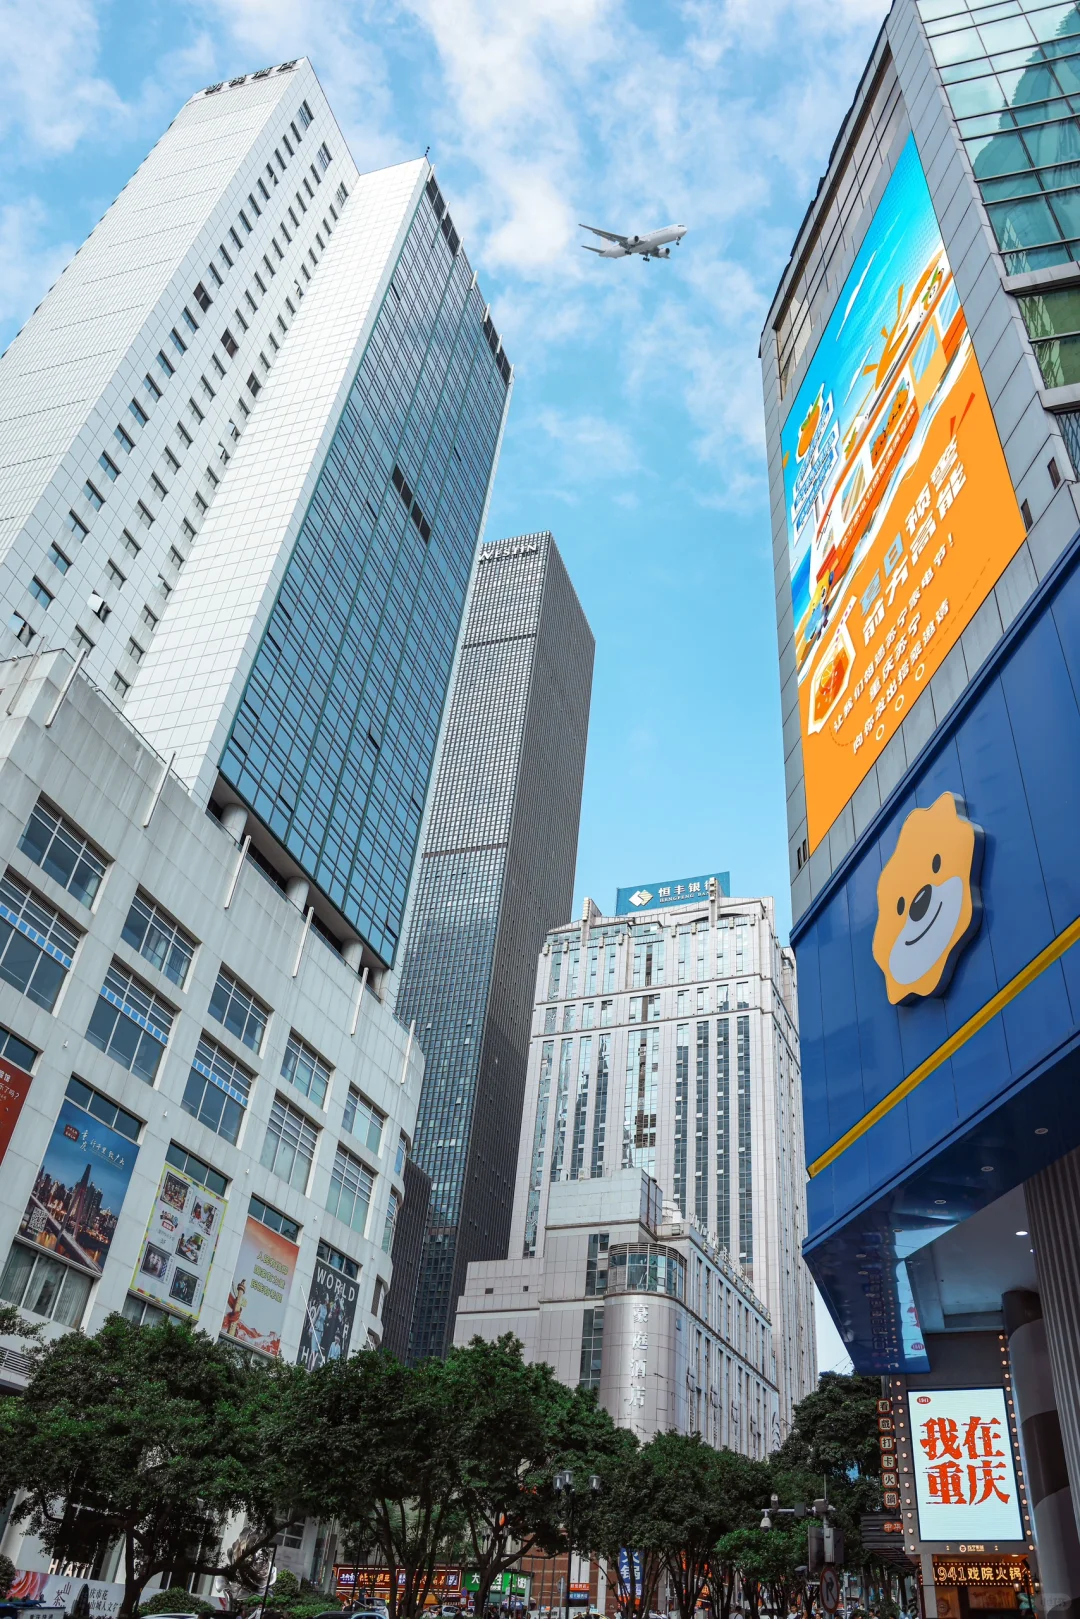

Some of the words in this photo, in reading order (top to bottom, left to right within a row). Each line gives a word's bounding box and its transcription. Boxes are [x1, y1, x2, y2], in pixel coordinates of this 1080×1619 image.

[860, 435, 957, 615] 夏日预警
[479, 543, 537, 560] WESTIN
[862, 462, 966, 645] 前方高能
[853, 599, 948, 753] 向你发出搭乘邀请
[869, 612, 920, 701] 重庆苏宁
[660, 893, 694, 903] HENGFENG
[317, 1267, 355, 1302] WORLD
[920, 1416, 1005, 1460] 我在
[922, 1460, 1010, 1505] 重庆
